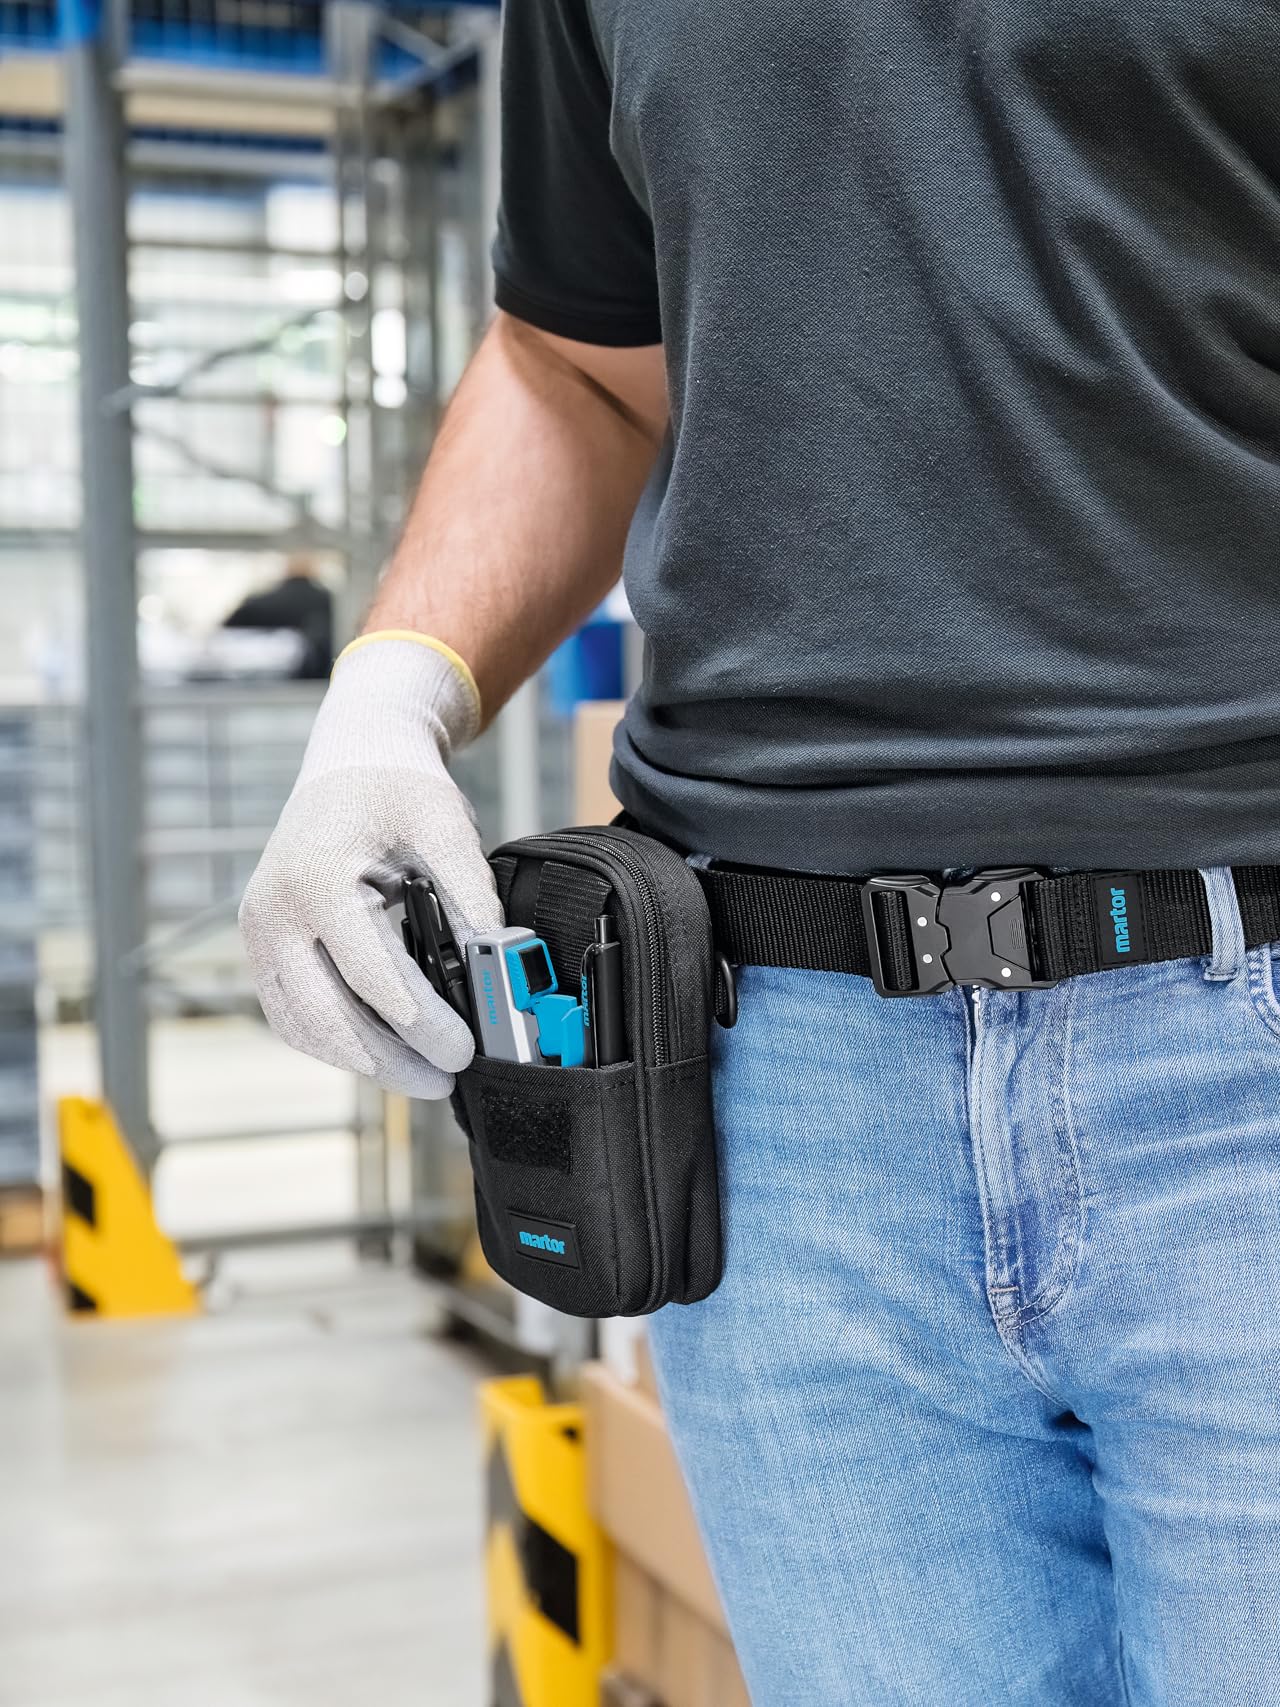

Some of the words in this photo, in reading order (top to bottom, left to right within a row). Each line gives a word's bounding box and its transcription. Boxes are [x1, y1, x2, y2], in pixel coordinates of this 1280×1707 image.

[1110, 888, 1130, 953] martor
[482, 969, 498, 1025] martor
[518, 1231, 566, 1255] martor
